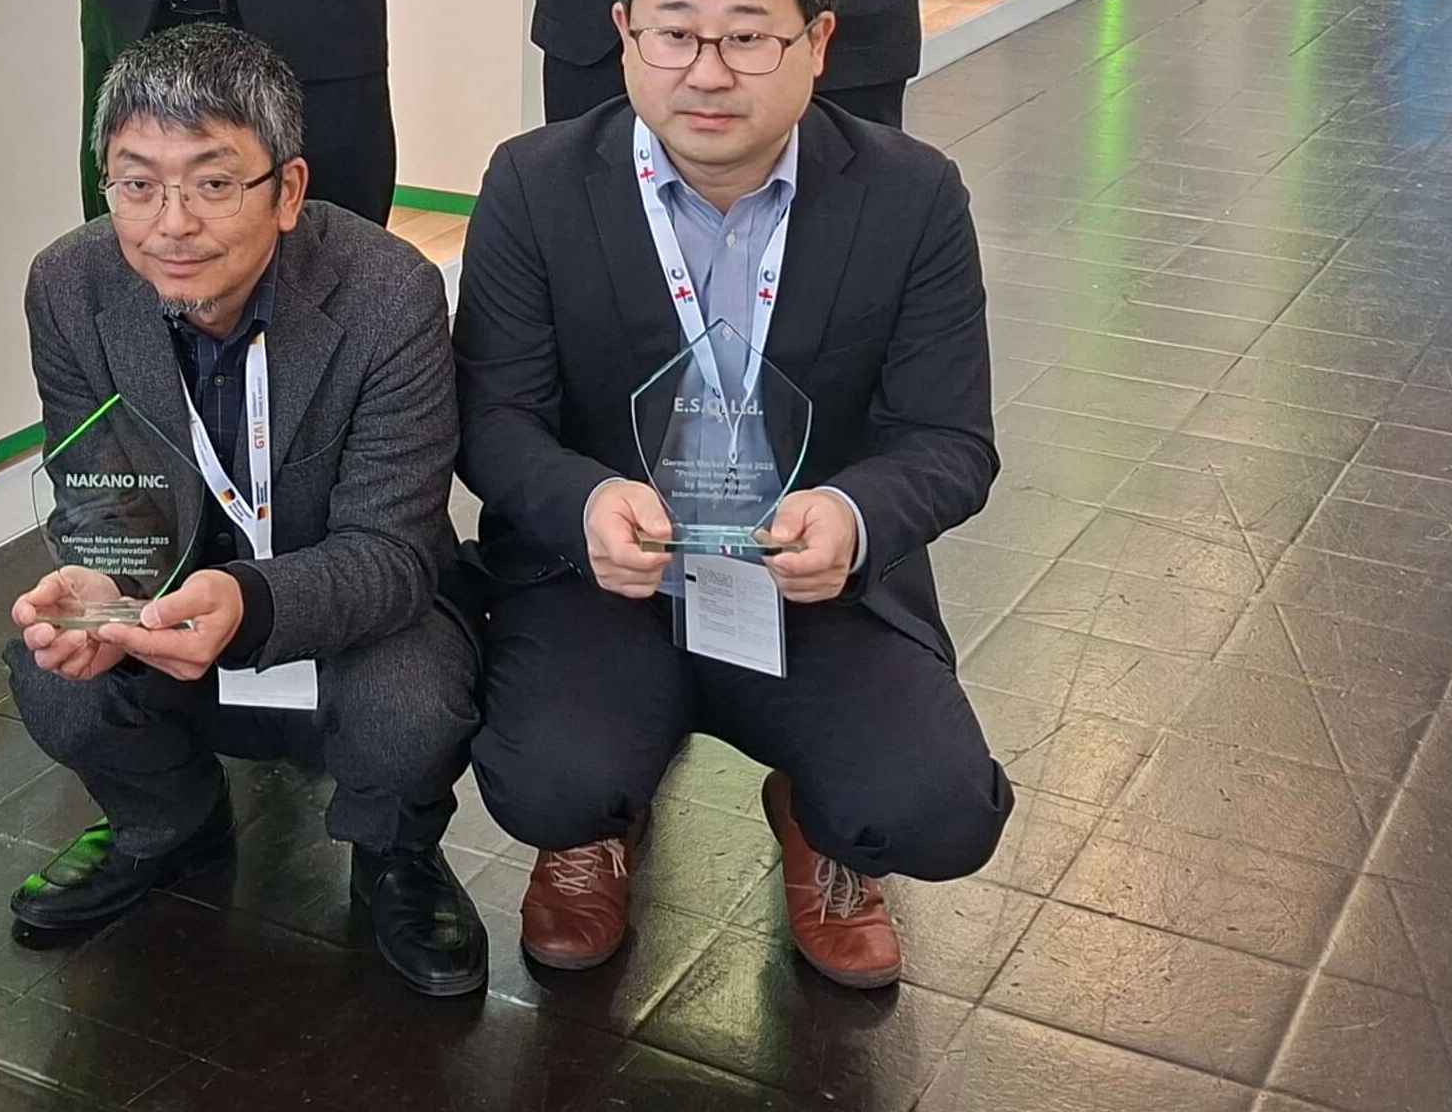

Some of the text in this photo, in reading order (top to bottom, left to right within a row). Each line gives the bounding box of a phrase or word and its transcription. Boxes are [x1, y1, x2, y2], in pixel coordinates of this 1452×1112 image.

[662, 458, 695, 467] German
[66, 473, 169, 489] NAKANO INC.
[61, 535, 169, 545] German Market Award 2025
[73, 546, 157, 555] "Product Innovation"
[83, 556, 93, 567] by
[95, 557, 120, 567] Birger
[121, 567, 160, 578] Academy
